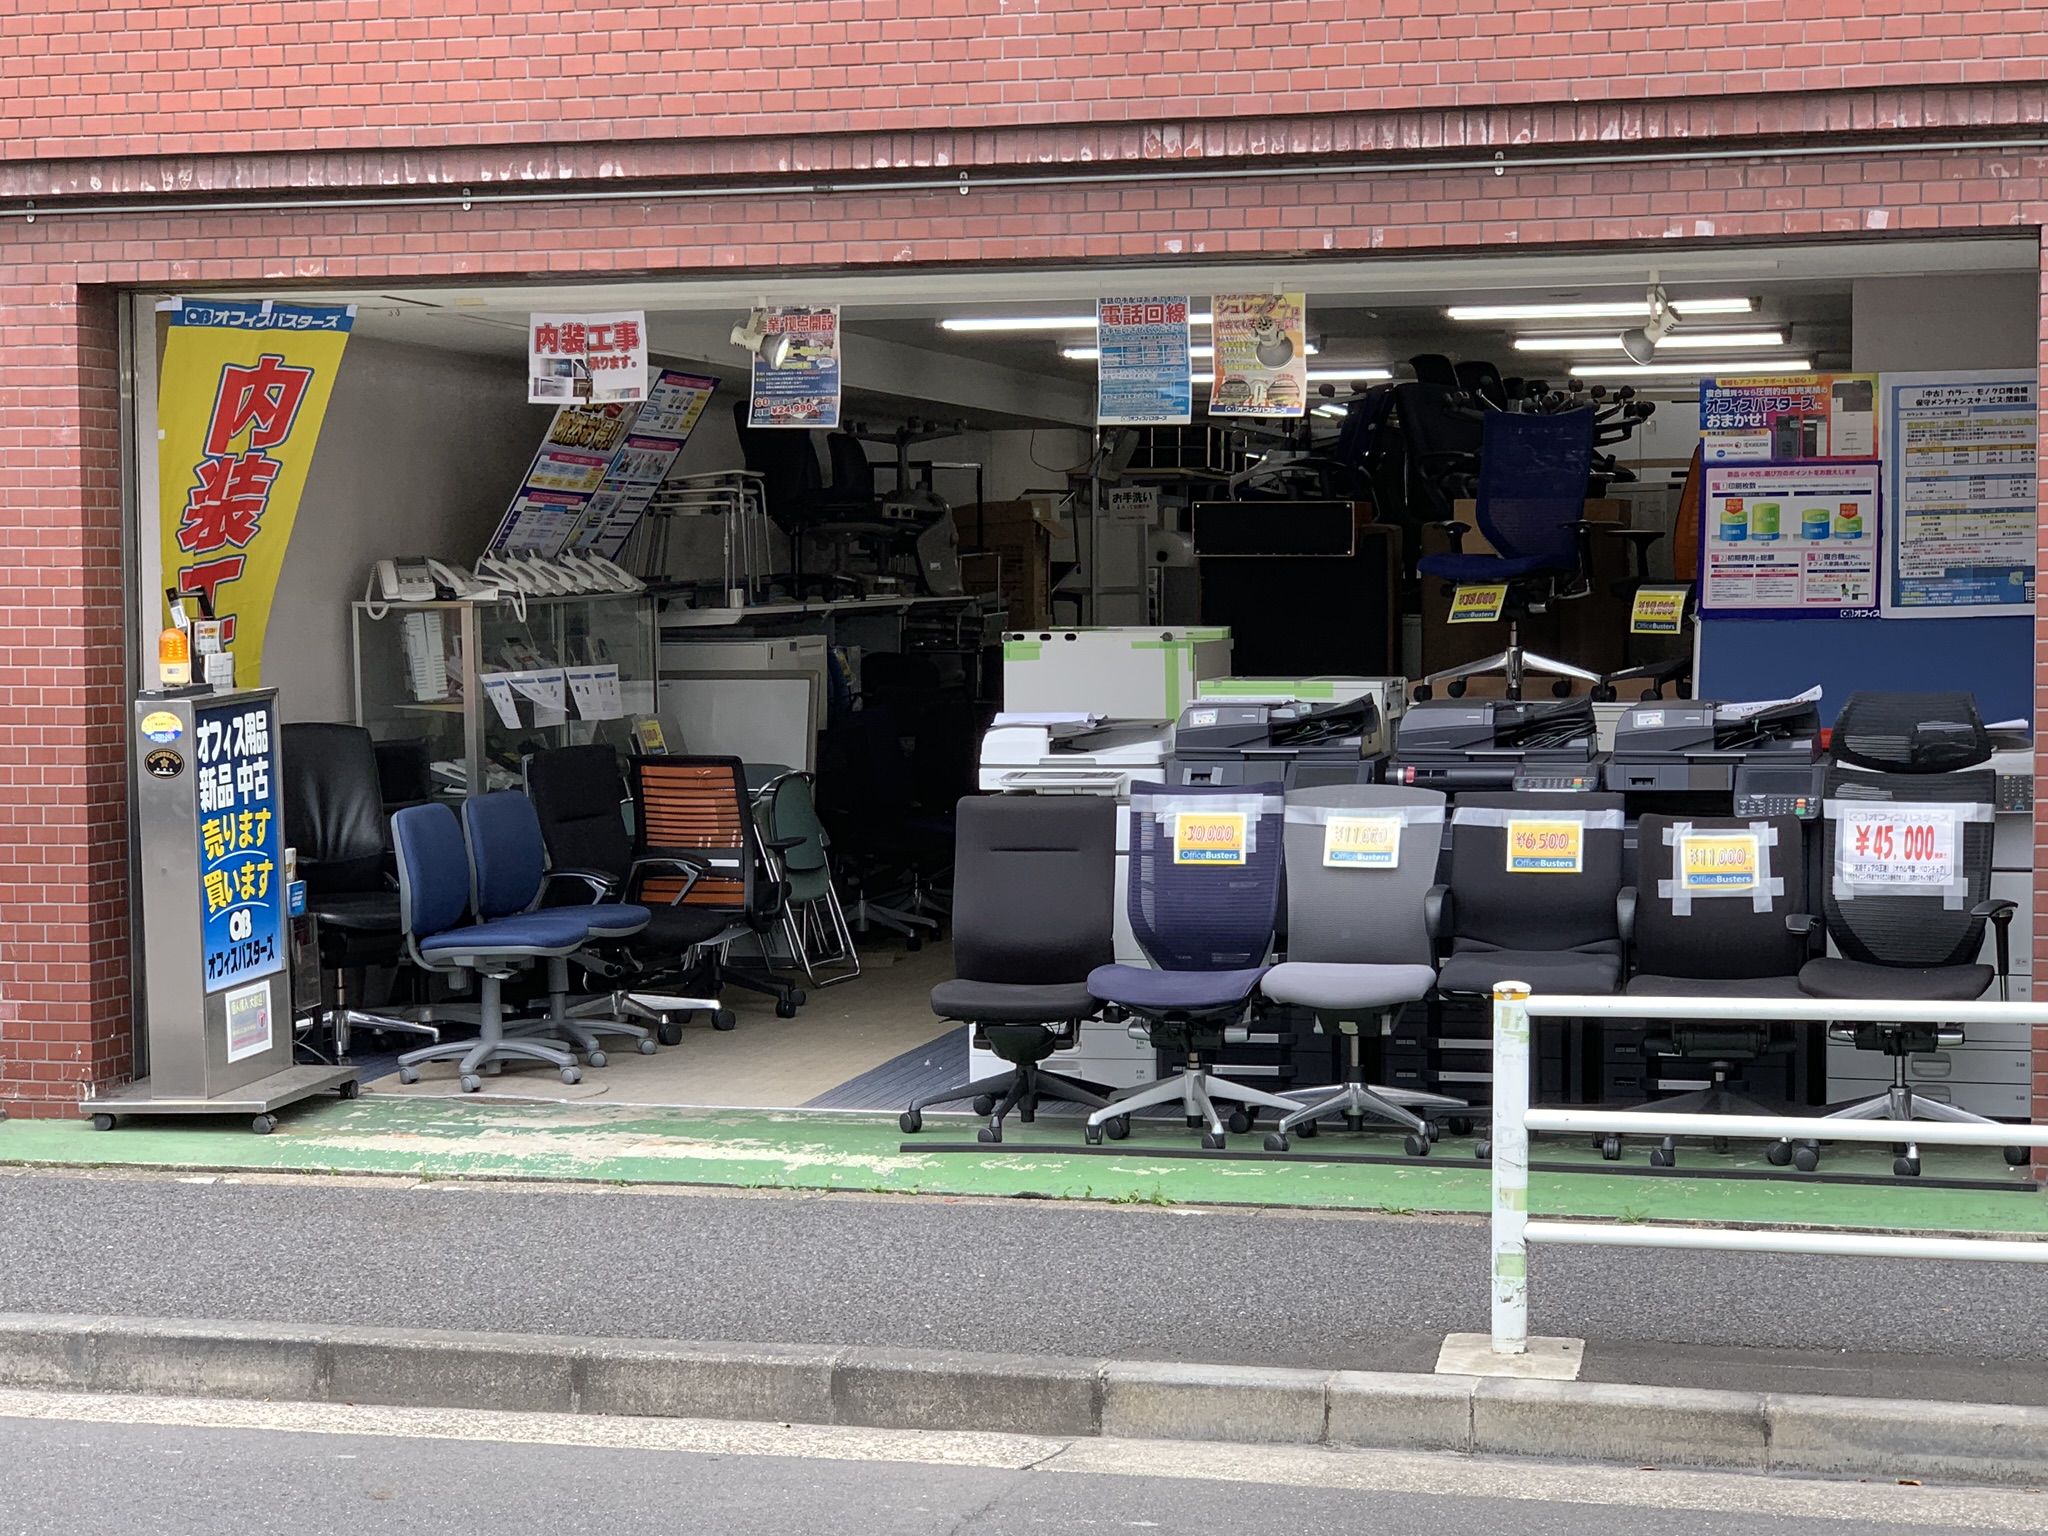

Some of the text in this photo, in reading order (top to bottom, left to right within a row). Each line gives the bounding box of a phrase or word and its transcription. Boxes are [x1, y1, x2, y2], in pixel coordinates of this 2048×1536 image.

[214, 310, 340, 328] オフィスバスターズ
[1101, 303, 1186, 326] 電話回線
[534, 321, 640, 355] 内装工事
[588, 355, 637, 371] 承ります。
[1705, 396, 1823, 413] オフィスバスターズに
[1706, 413, 1767, 428] おまかせ!
[1728, 482, 1756, 490] 印刷枚数
[1112, 491, 1153, 503] お手洗い
[1727, 553, 1775, 562] 初期費用と総額
[1453, 611, 1494, 619] OfficeBusters
[1636, 622, 1675, 630] OfficeBusters
[197, 710, 268, 763] オフィス用品
[199, 762, 234, 813] 新品
[237, 756, 269, 804] 中古
[1868, 812, 1950, 823] オフィスバスターズ
[201, 807, 272, 860] 売ります
[1855, 825, 1935, 861] ¥45,000
[1181, 850, 1239, 860] OfficeBusters
[1332, 851, 1390, 861] OfficeBusters
[1515, 858, 1574, 868] OfficeBusters
[203, 858, 273, 914] 買います
[1690, 875, 1752, 884] OfficeBusters
[208, 933, 275, 980] オフィスバスターズ
